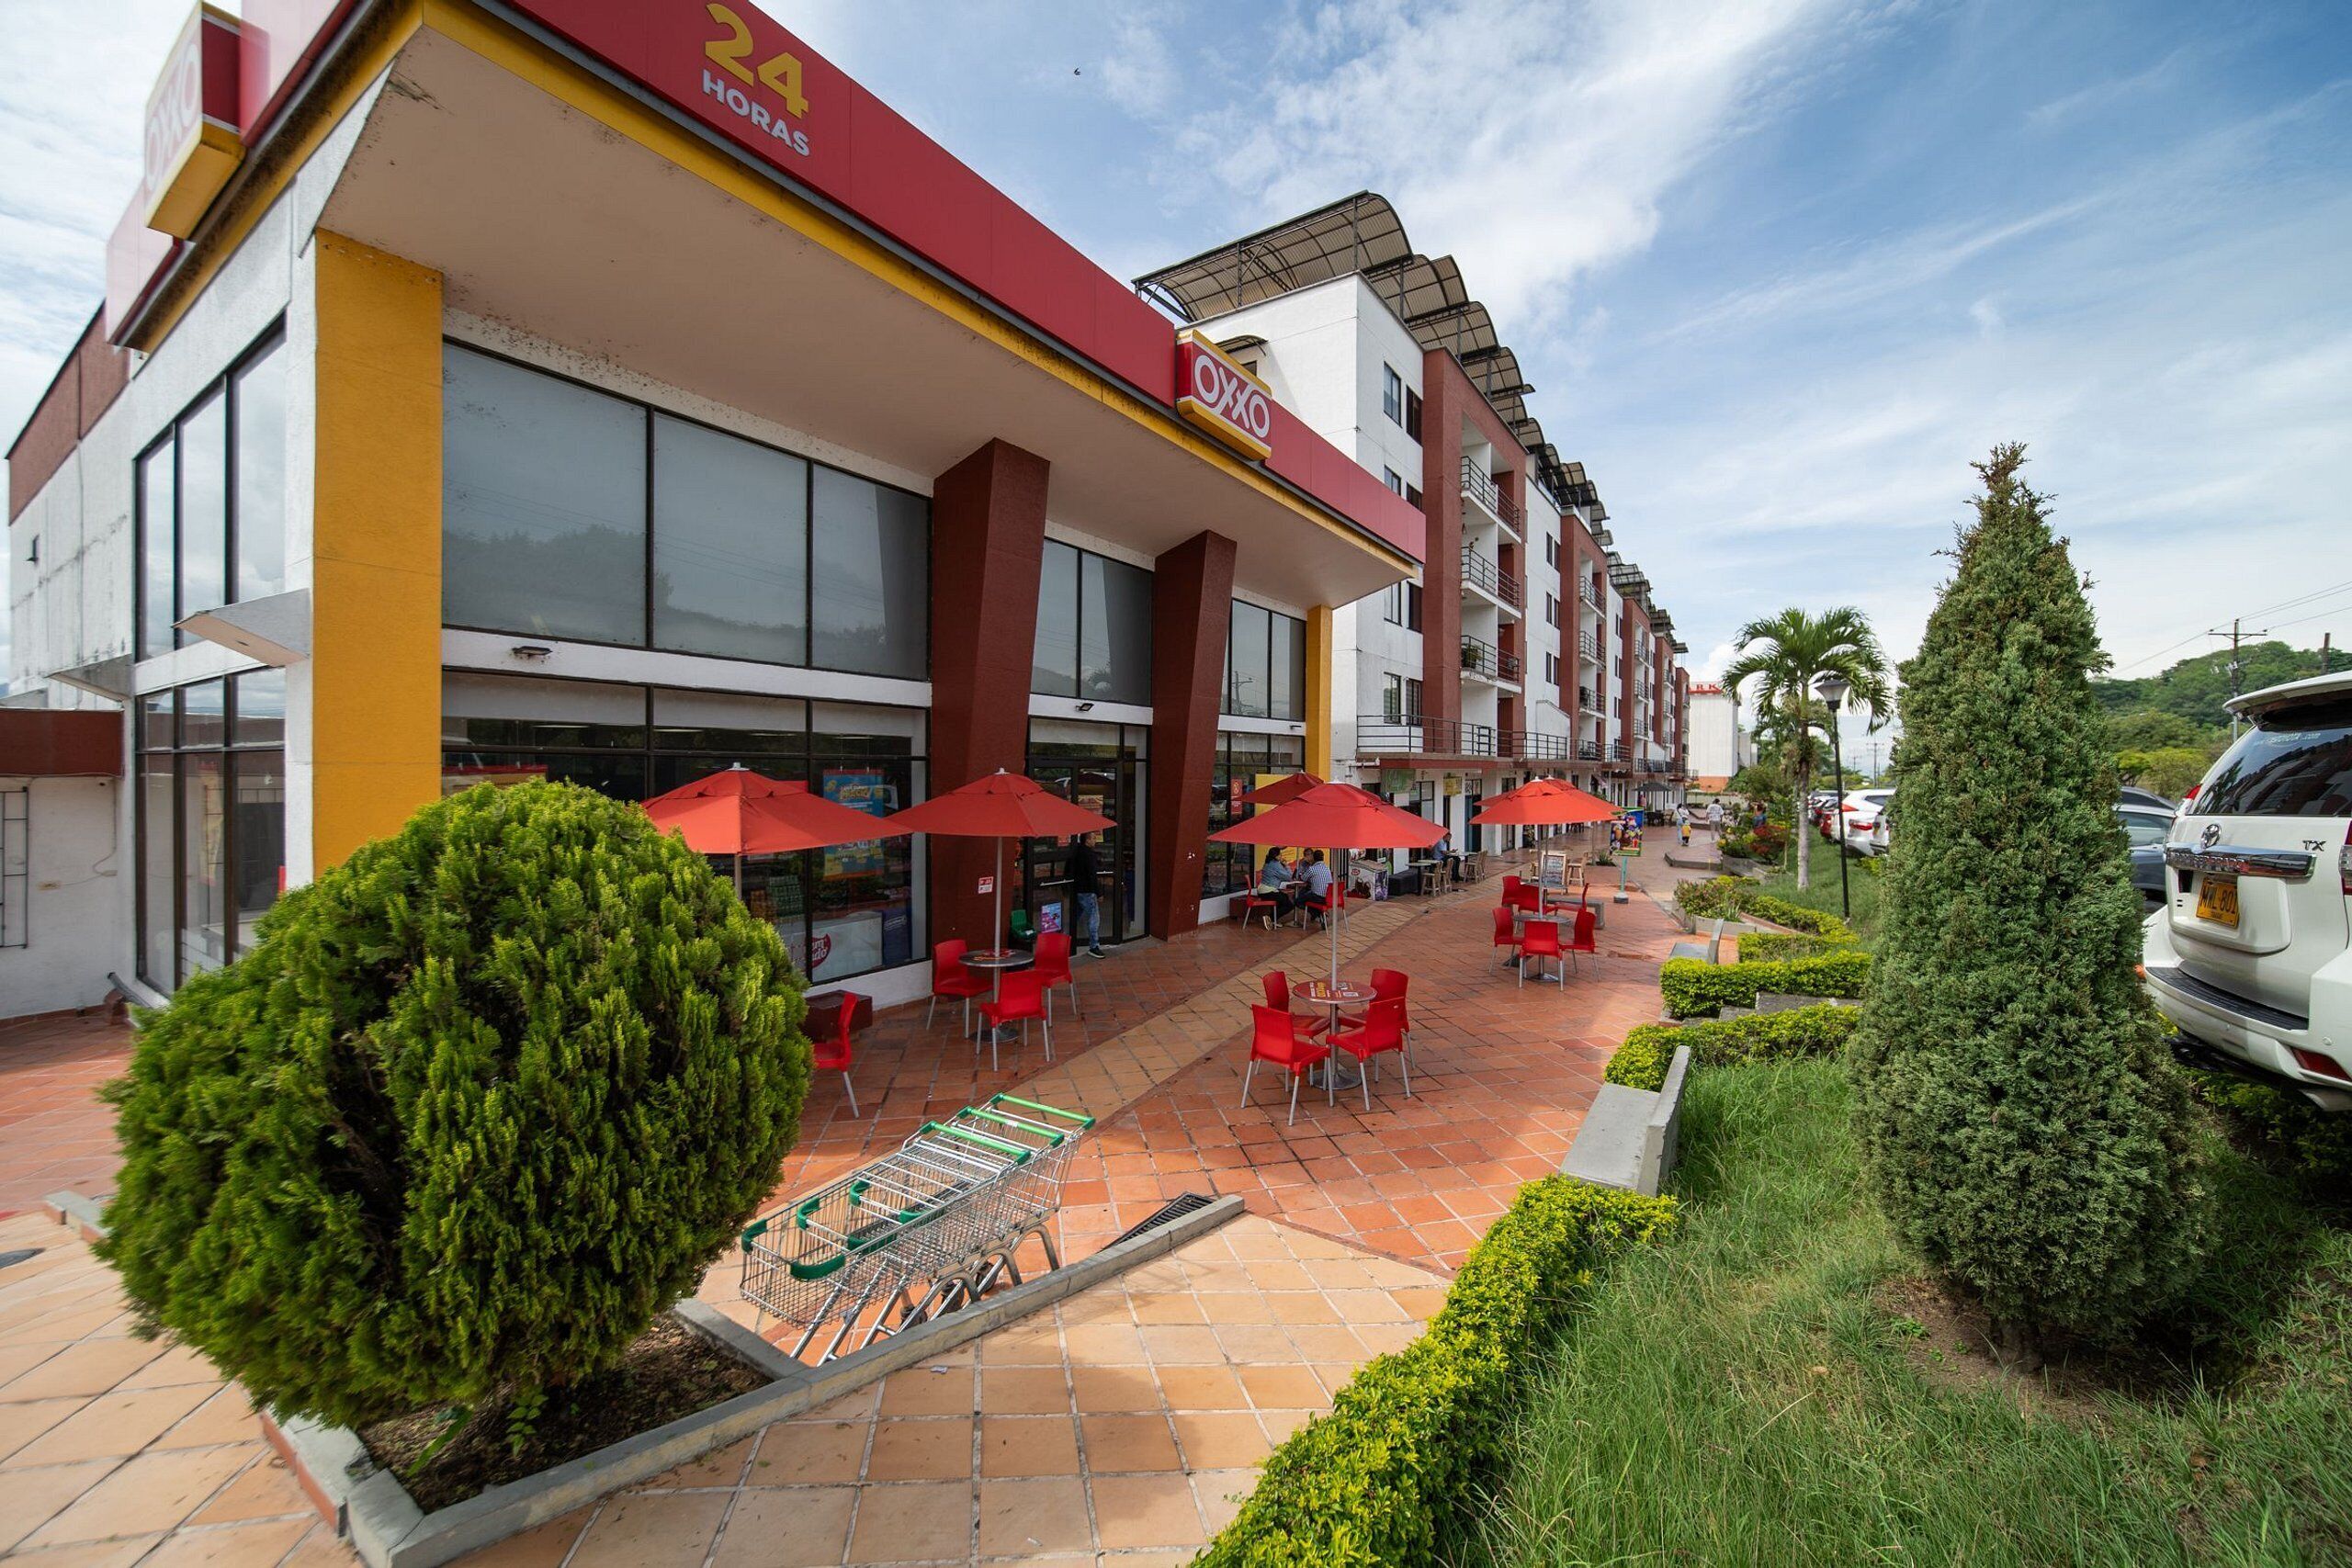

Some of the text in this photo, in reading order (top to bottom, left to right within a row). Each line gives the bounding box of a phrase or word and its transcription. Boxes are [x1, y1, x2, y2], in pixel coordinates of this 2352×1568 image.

[706, 4, 808, 118] 24
[145, 42, 199, 191] OXXO
[703, 69, 809, 156] HORAS
[1194, 355, 1270, 438] OXXO
[2302, 840, 2326, 852] TX
